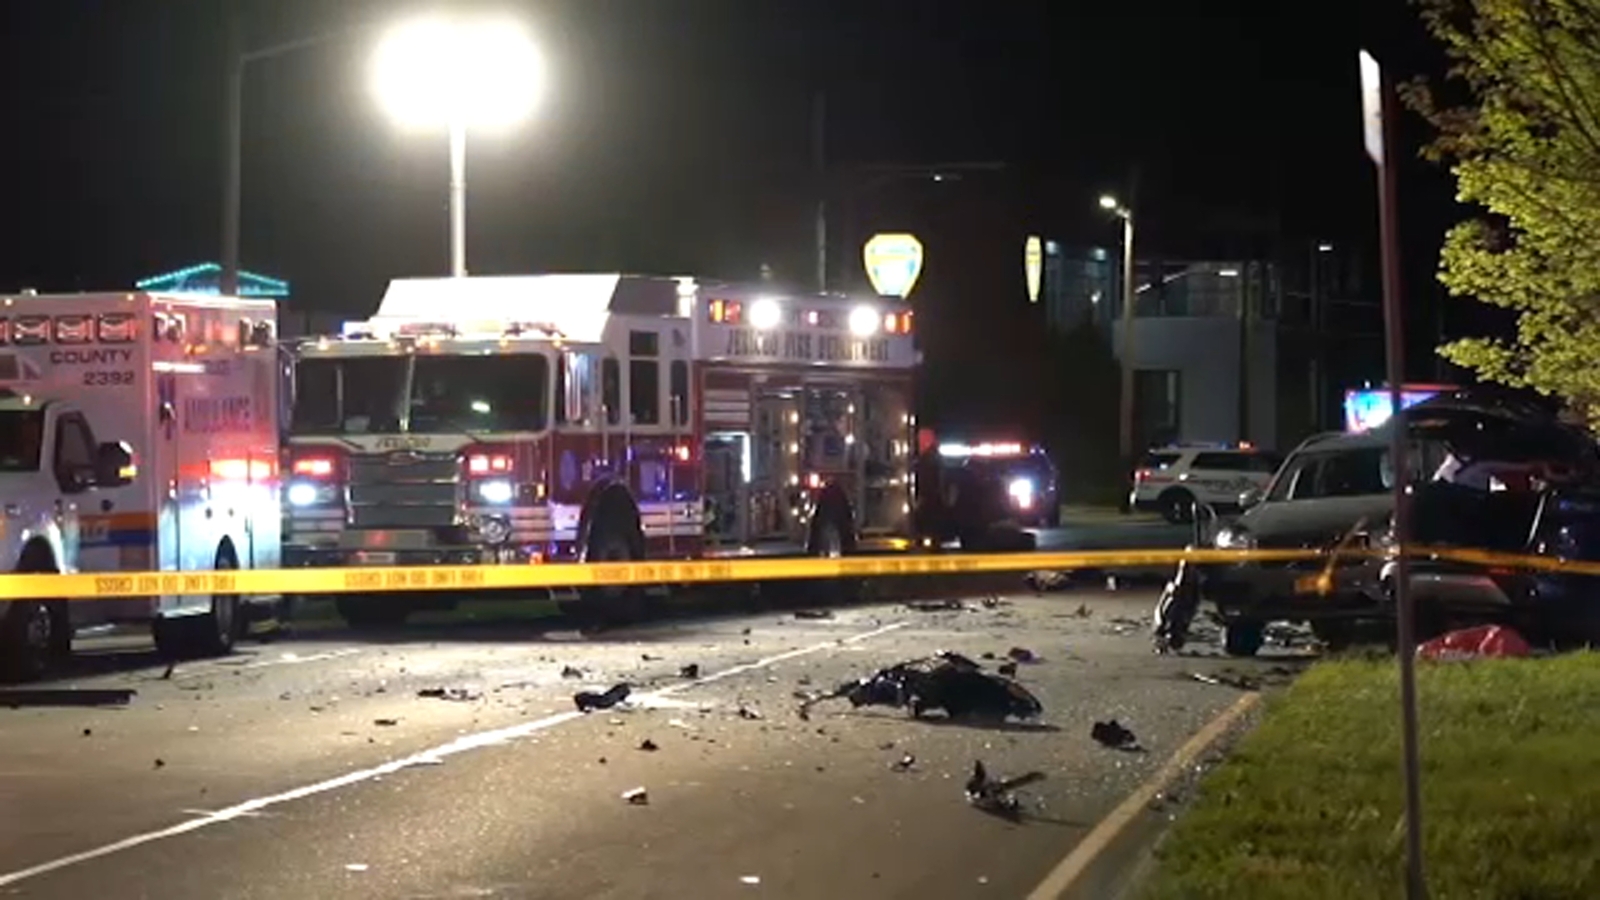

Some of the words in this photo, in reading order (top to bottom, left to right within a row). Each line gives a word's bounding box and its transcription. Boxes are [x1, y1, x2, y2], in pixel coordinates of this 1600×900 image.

[784, 331, 811, 359] FIRE
[49, 348, 132, 365] COUNTY
[83, 370, 135, 386] 2392
[95, 576, 133, 592] CROSS
[138, 576, 158, 592] NOT
[162, 575, 178, 591] DO
